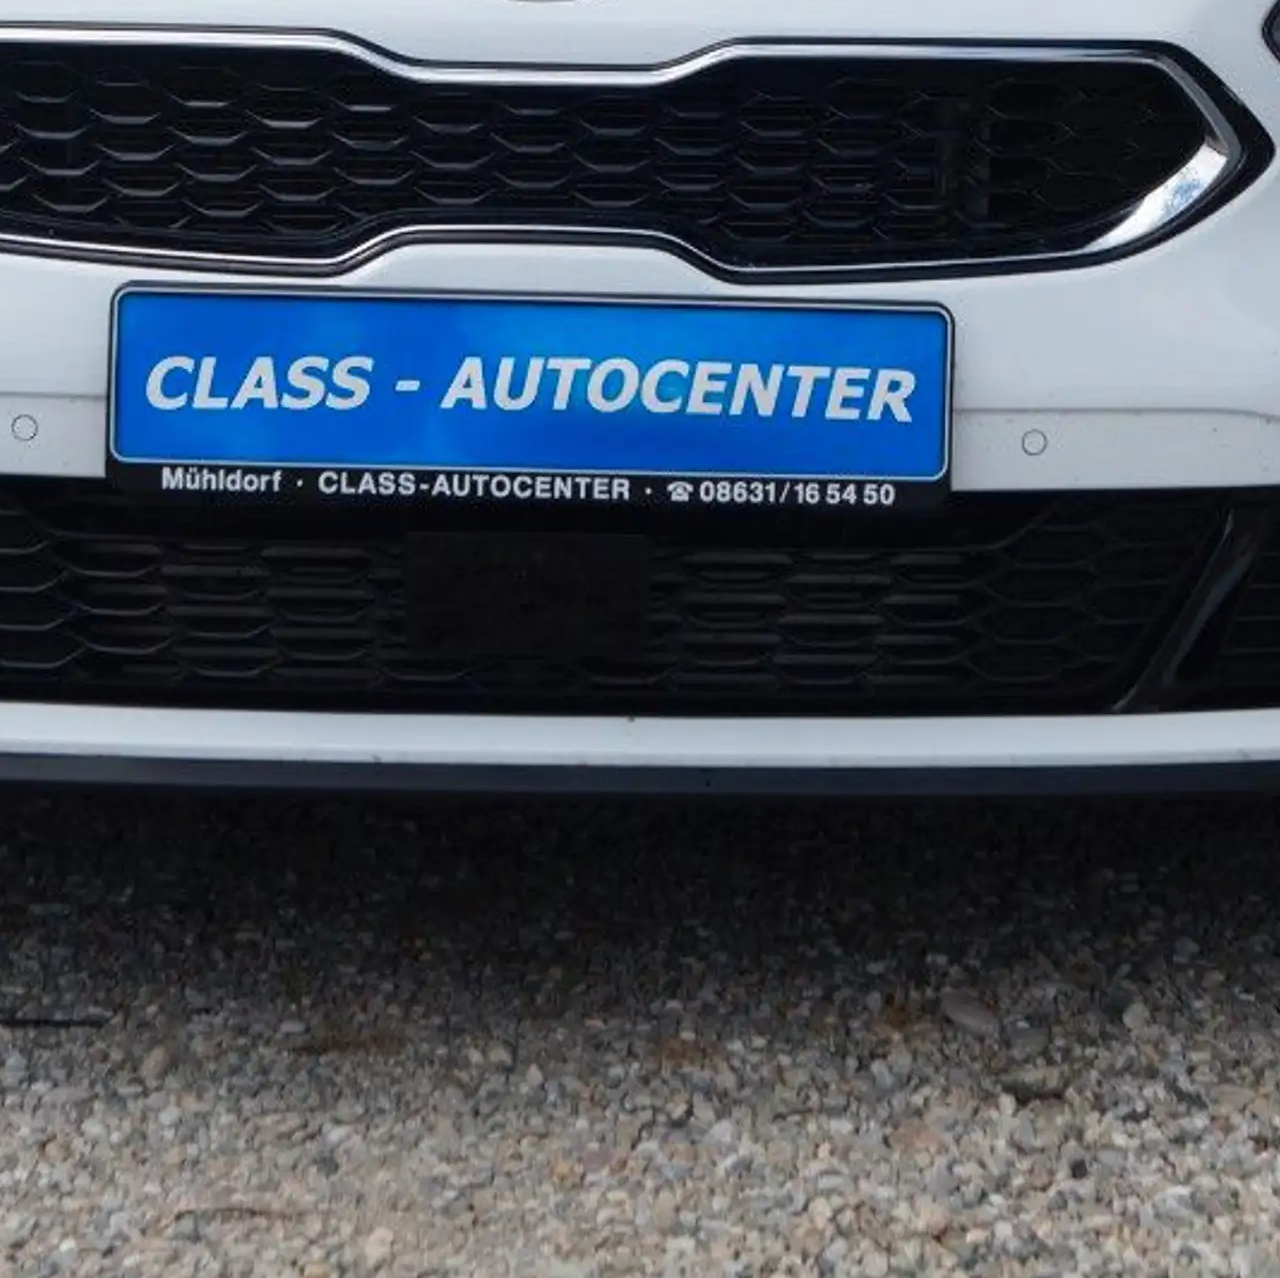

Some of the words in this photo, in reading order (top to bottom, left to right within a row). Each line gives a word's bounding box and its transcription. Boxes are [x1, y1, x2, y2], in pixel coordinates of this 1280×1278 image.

[145, 355, 375, 411] CLASS
[440, 355, 917, 423] AUTOCENTER
[161, 466, 283, 493] Mühldorf
[317, 470, 631, 501] CLASS-AUTOCENTER
